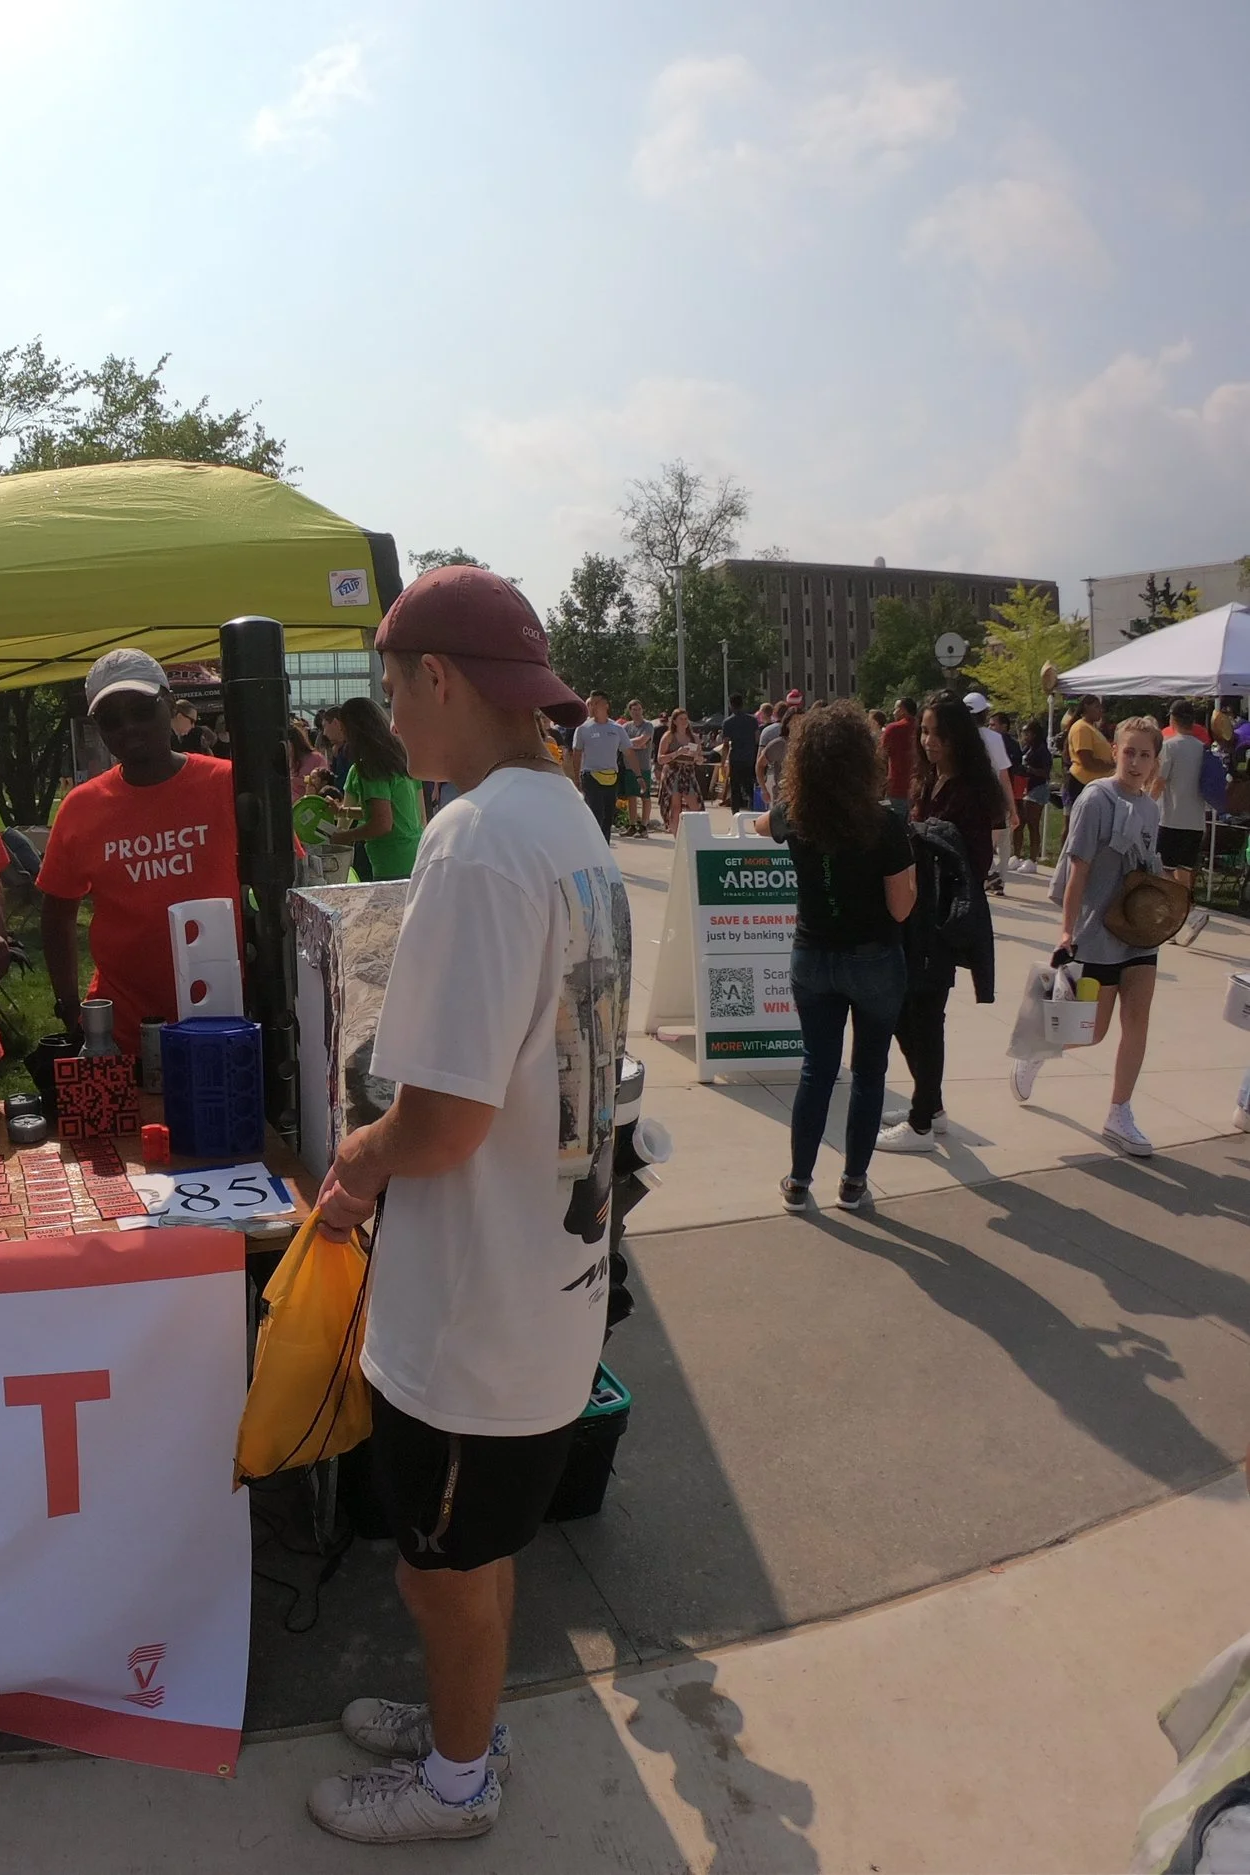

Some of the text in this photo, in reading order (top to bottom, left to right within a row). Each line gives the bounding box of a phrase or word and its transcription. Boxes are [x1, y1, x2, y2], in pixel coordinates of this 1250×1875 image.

[104, 824, 209, 862] PROJECT
[125, 852, 193, 883] VINCI
[725, 858, 742, 866] GET
[719, 870, 799, 888] ARBOR
[710, 916, 739, 925] SAVE
[742, 916, 750, 924] &
[753, 916, 782, 924] EARN
[706, 931, 726, 942] just
[729, 931, 740, 941] by
[744, 930, 784, 941] banking
[763, 1002, 790, 1013] WIN
